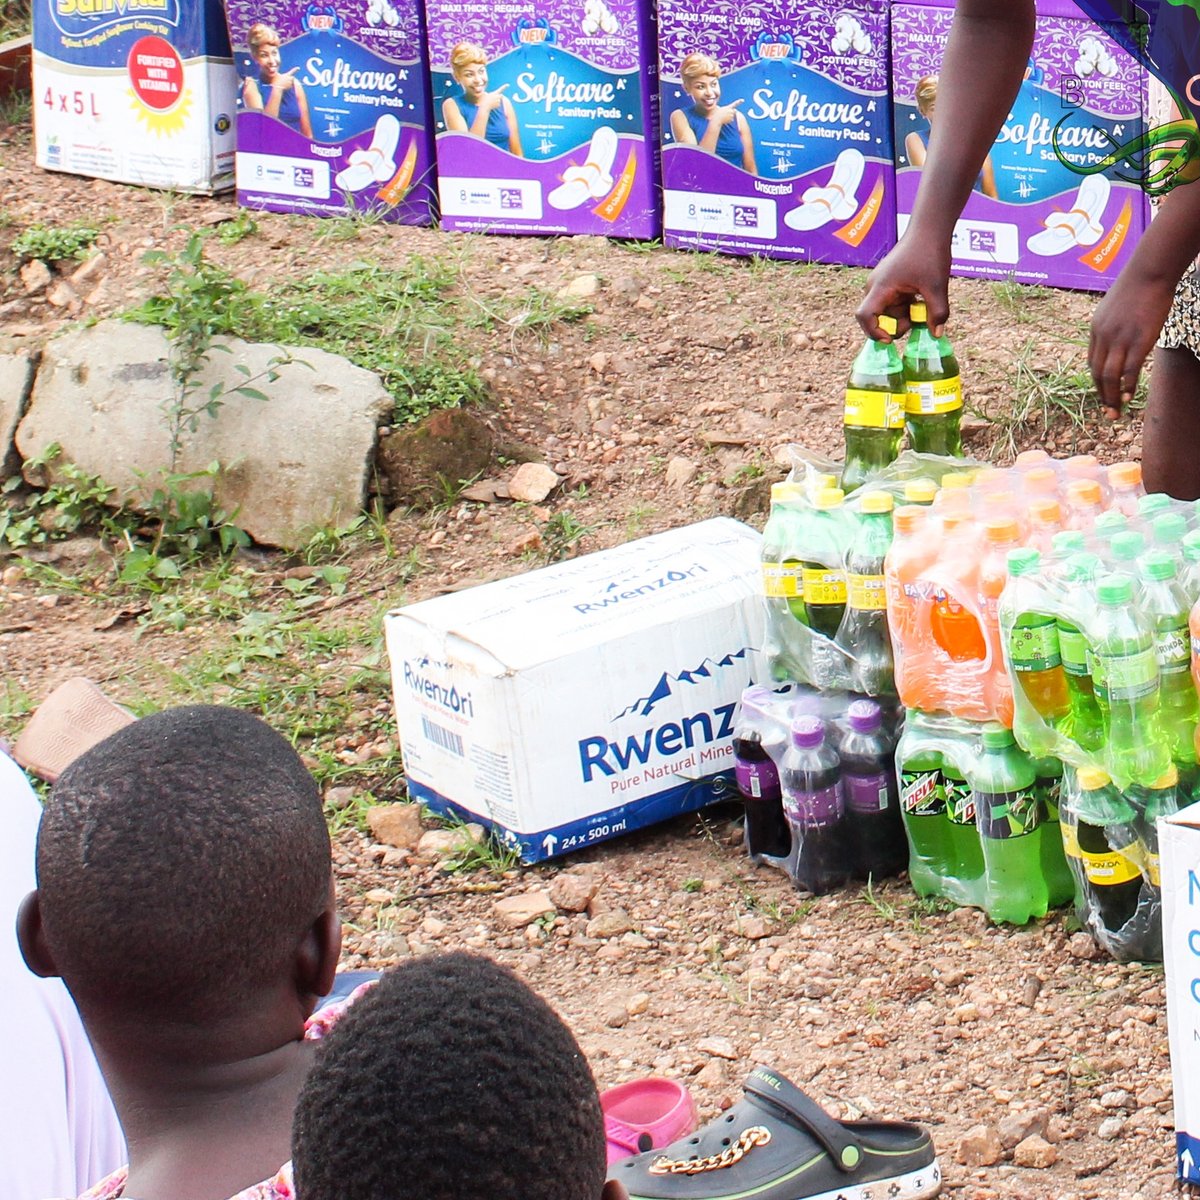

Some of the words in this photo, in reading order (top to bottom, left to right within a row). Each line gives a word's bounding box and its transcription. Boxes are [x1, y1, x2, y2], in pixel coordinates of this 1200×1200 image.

[137, 55, 176, 68] FORTIFIED
[759, 42, 790, 59] NEW
[139, 79, 170, 92] VITAMIN
[170, 83, 178, 93] A
[147, 68, 167, 79] WITH
[302, 57, 397, 98] Softcare
[44, 87, 54, 110] 4
[59, 94, 68, 112] x
[74, 91, 84, 114] 5
[91, 93, 100, 116] L
[512, 70, 615, 113] Softcare
[557, 106, 597, 120] Sanitary
[596, 107, 621, 119] Pads
[748, 88, 864, 131] Softcare
[799, 126, 843, 142] Sanitary
[843, 128, 870, 143] Pads
[754, 180, 792, 195] Unscented
[573, 563, 708, 614] Rwenzori
[404, 661, 473, 718] Rwenzori
[578, 702, 737, 783] Rwenz
[611, 775, 640, 794] Pure
[644, 753, 696, 787] Natural
[700, 745, 733, 764] Mine
[562, 837, 577, 849] 24
[578, 835, 585, 844] x
[588, 827, 609, 840] 500
[612, 819, 627, 833] ml
